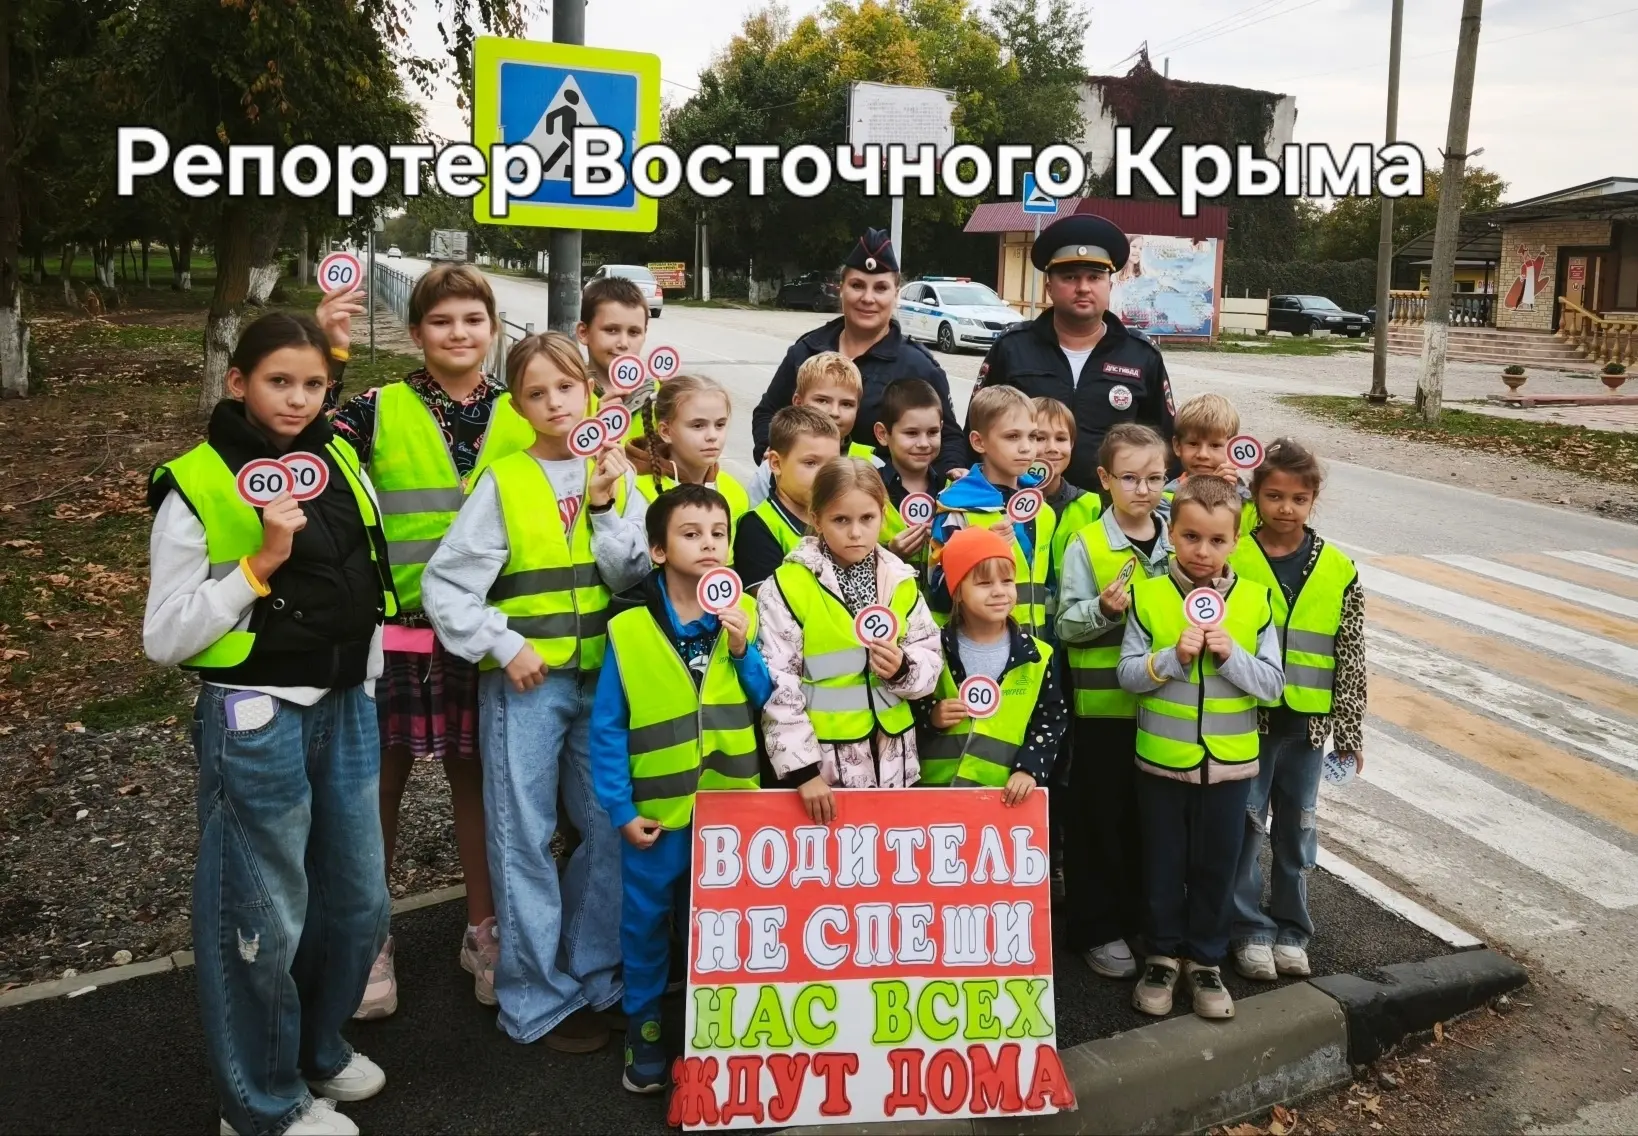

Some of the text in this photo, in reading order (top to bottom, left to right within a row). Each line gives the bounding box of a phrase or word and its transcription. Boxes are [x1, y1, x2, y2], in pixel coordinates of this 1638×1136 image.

[327, 264, 353, 284] 60
[617, 365, 638, 381] 60
[1105, 364, 1139, 377] ДПС ГИБДД
[576, 426, 600, 448] 60
[1234, 443, 1256, 460] 60
[249, 473, 283, 493] 60
[908, 503, 929, 518] 60
[1014, 497, 1036, 513] 60
[1195, 596, 1215, 620] 60
[864, 614, 889, 639] 60
[968, 687, 992, 705] 60
[698, 823, 1049, 888] ВОДИТЕЛЬ
[695, 901, 1035, 972] НЕ СПЕШИ
[691, 978, 1054, 1049] НАС ВСЕХ
[667, 1043, 1077, 1127] ЖДУТ ДОМА
